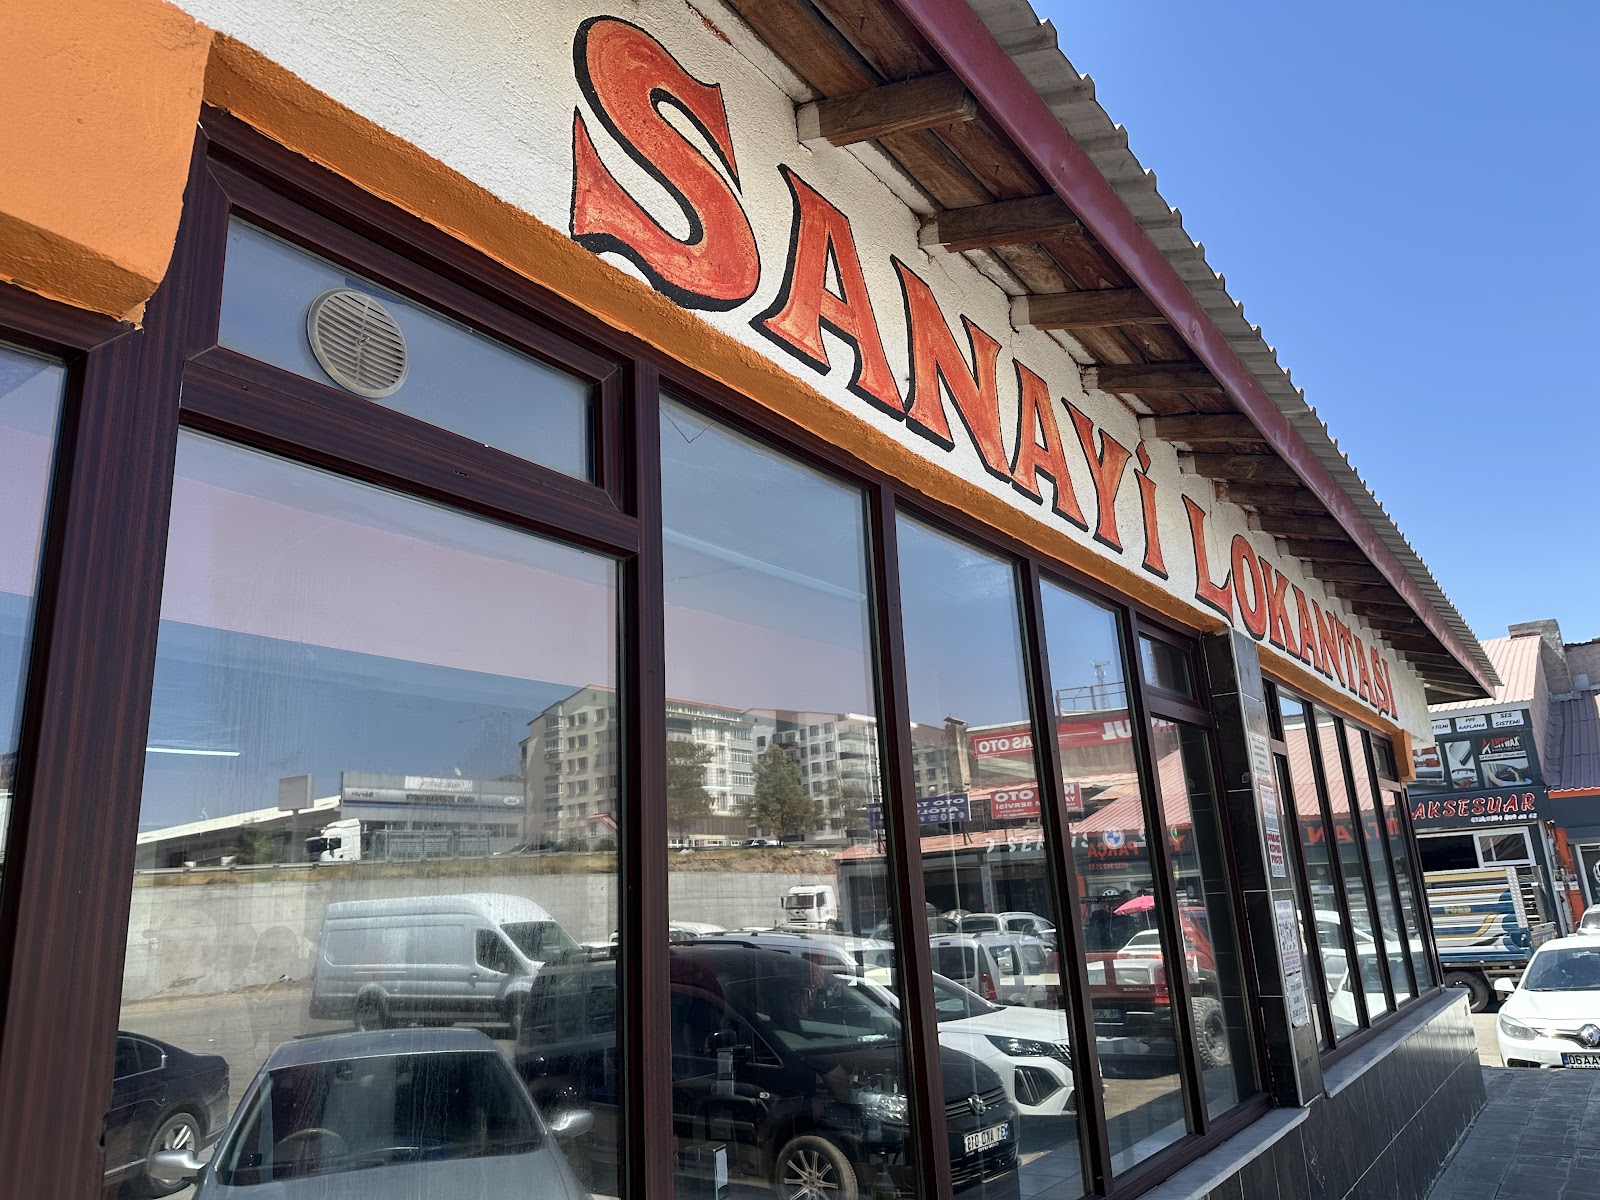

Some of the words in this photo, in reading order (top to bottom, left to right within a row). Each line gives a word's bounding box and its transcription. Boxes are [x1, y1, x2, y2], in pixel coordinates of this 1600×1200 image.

[569, 15, 1168, 580] SANAYİ
[1181, 494, 1398, 721] LOKANTASI
[1411, 793, 1536, 820] AKSESUAR
